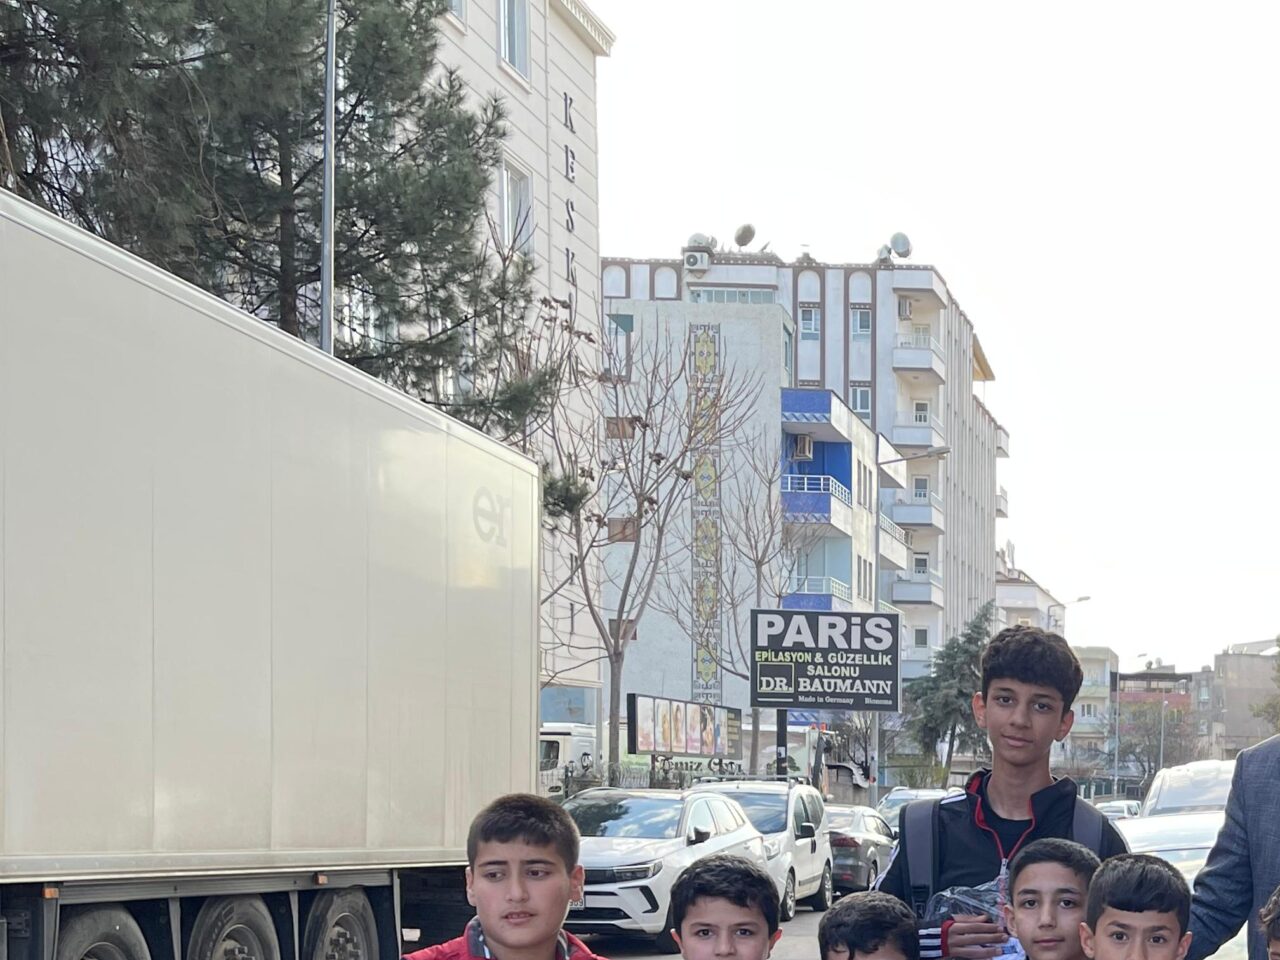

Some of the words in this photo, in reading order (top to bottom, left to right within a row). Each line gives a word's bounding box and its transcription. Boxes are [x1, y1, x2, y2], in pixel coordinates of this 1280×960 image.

[755, 650, 812, 662] EPİLASYON
[814, 652, 824, 663] &
[828, 651, 892, 666] GÜZELLİK
[807, 665, 859, 677] SALONU
[760, 677, 792, 691] DR.
[798, 678, 892, 694] BAUMANN
[825, 697, 854, 705] Germany
